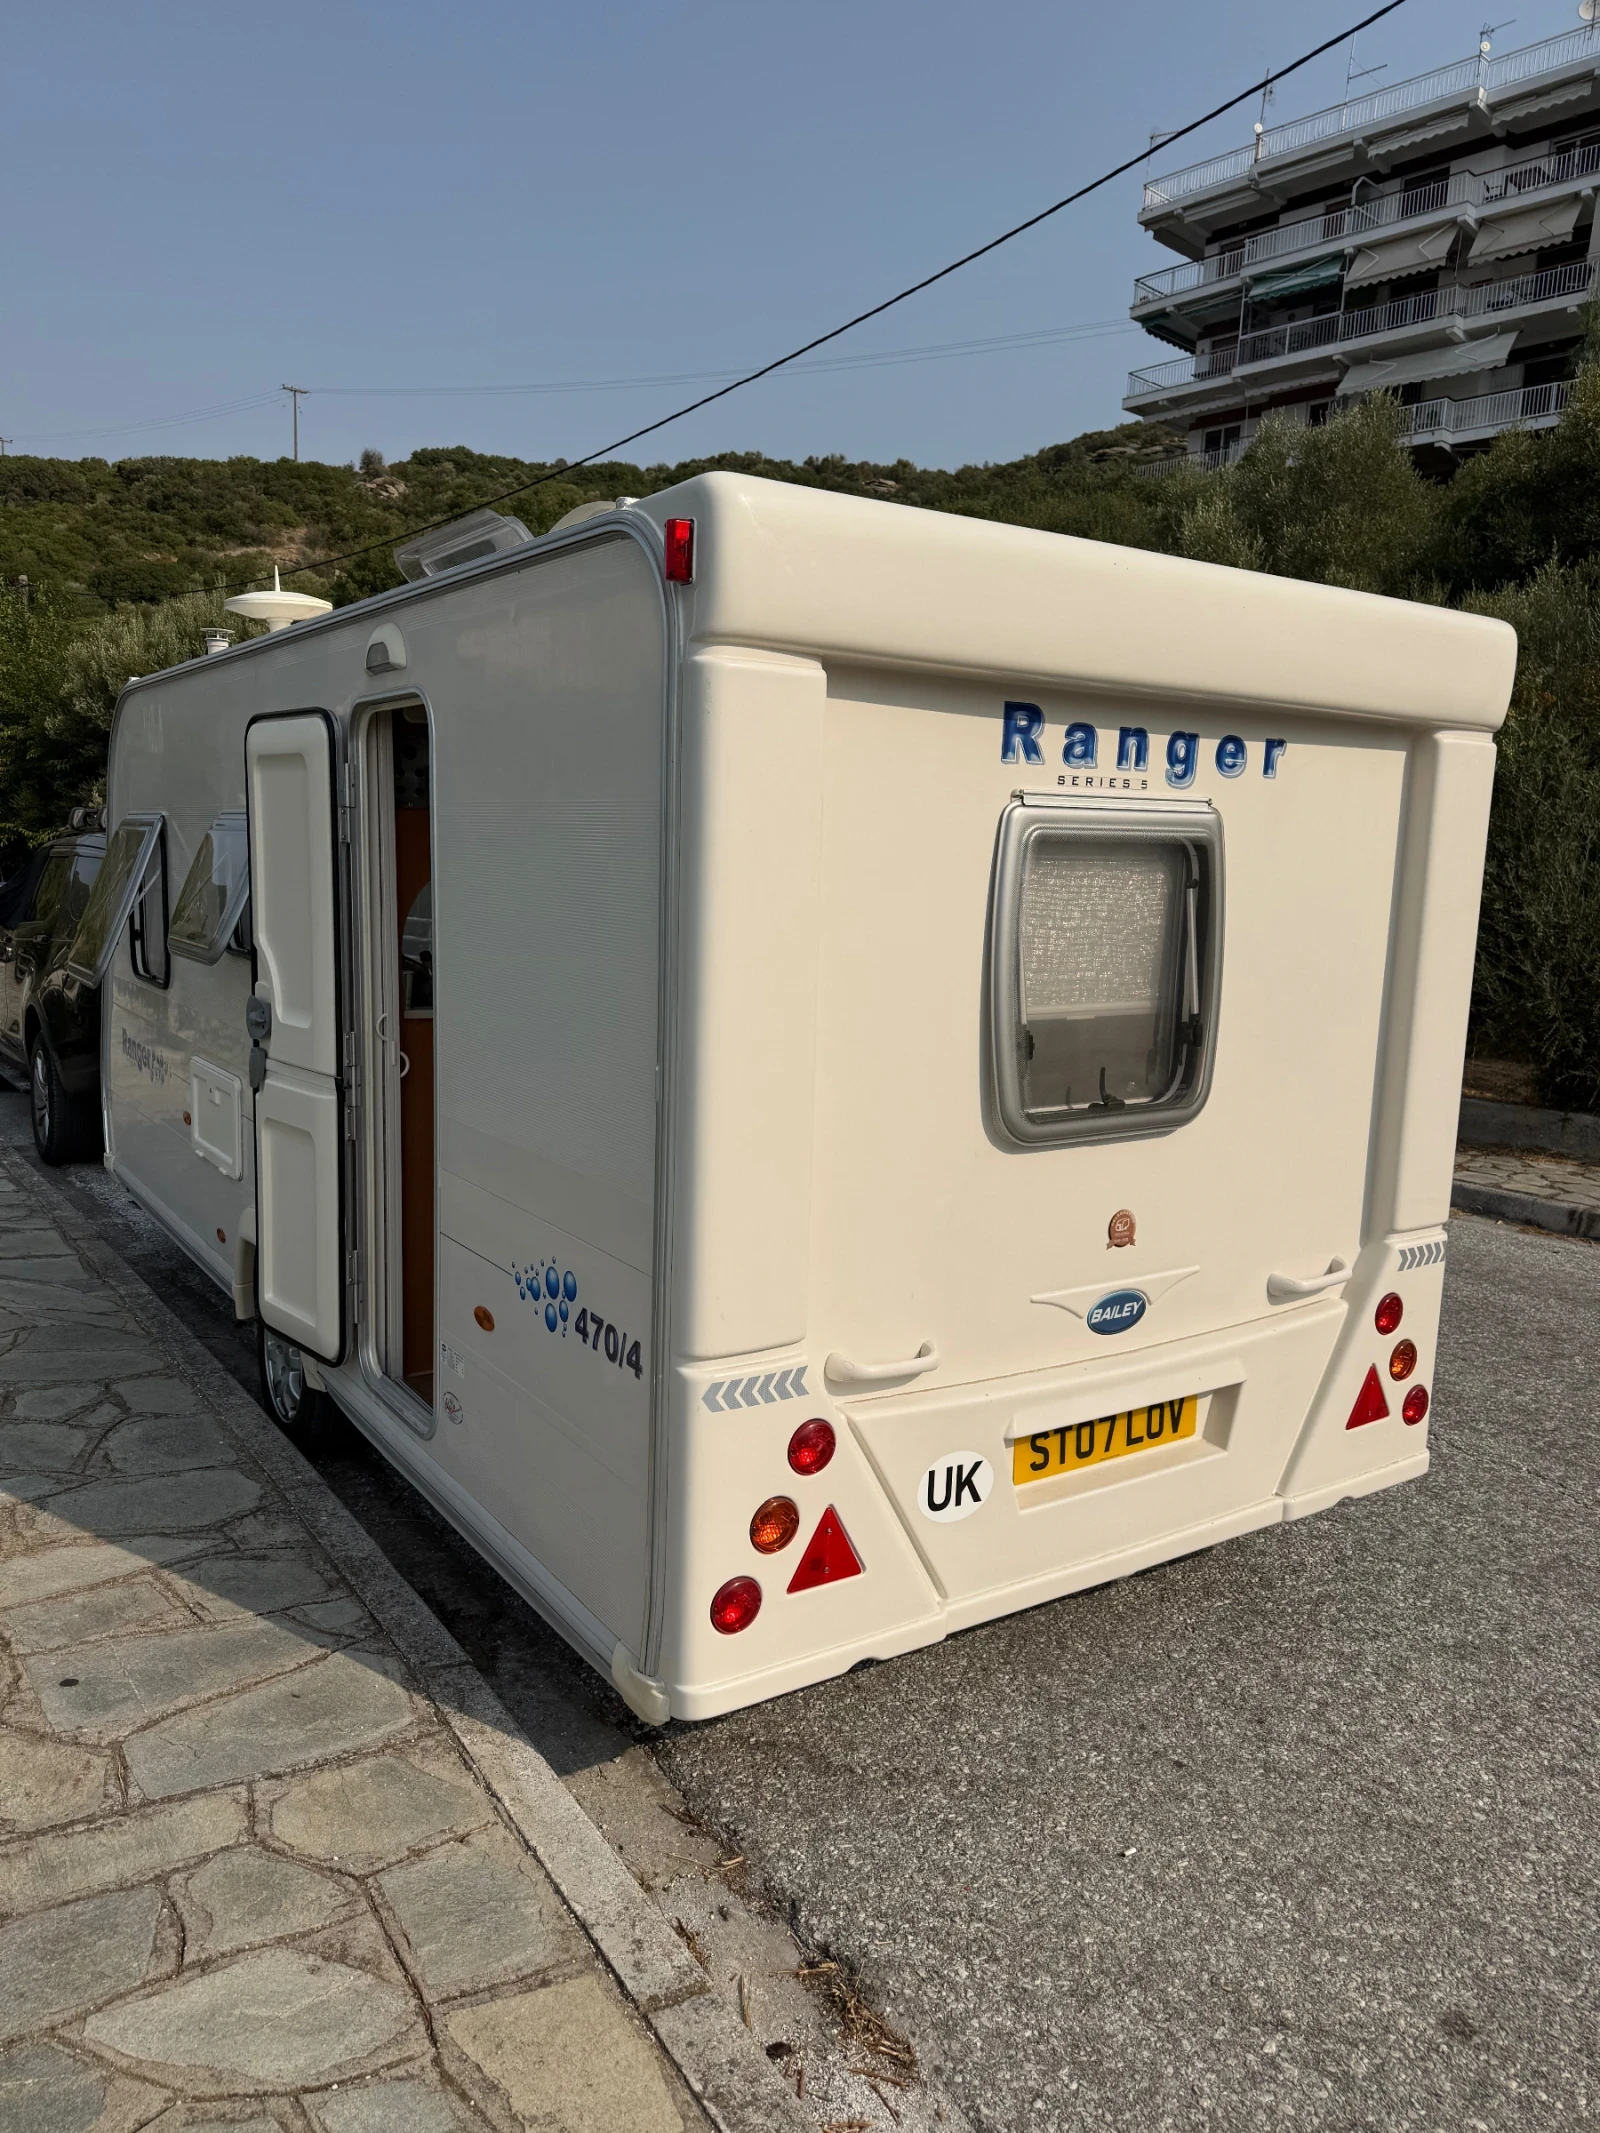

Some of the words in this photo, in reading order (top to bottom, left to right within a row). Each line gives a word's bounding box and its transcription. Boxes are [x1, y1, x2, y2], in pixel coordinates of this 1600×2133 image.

[1001, 700, 1287, 788] Ranger
[1057, 775, 1130, 789] SERIES
[1140, 779, 1148, 790] 5
[122, 1026, 152, 1073] Ranger
[1090, 1300, 1143, 1324] BAILEY
[575, 1307, 644, 1381] 470/4
[926, 1460, 984, 1512] UK
